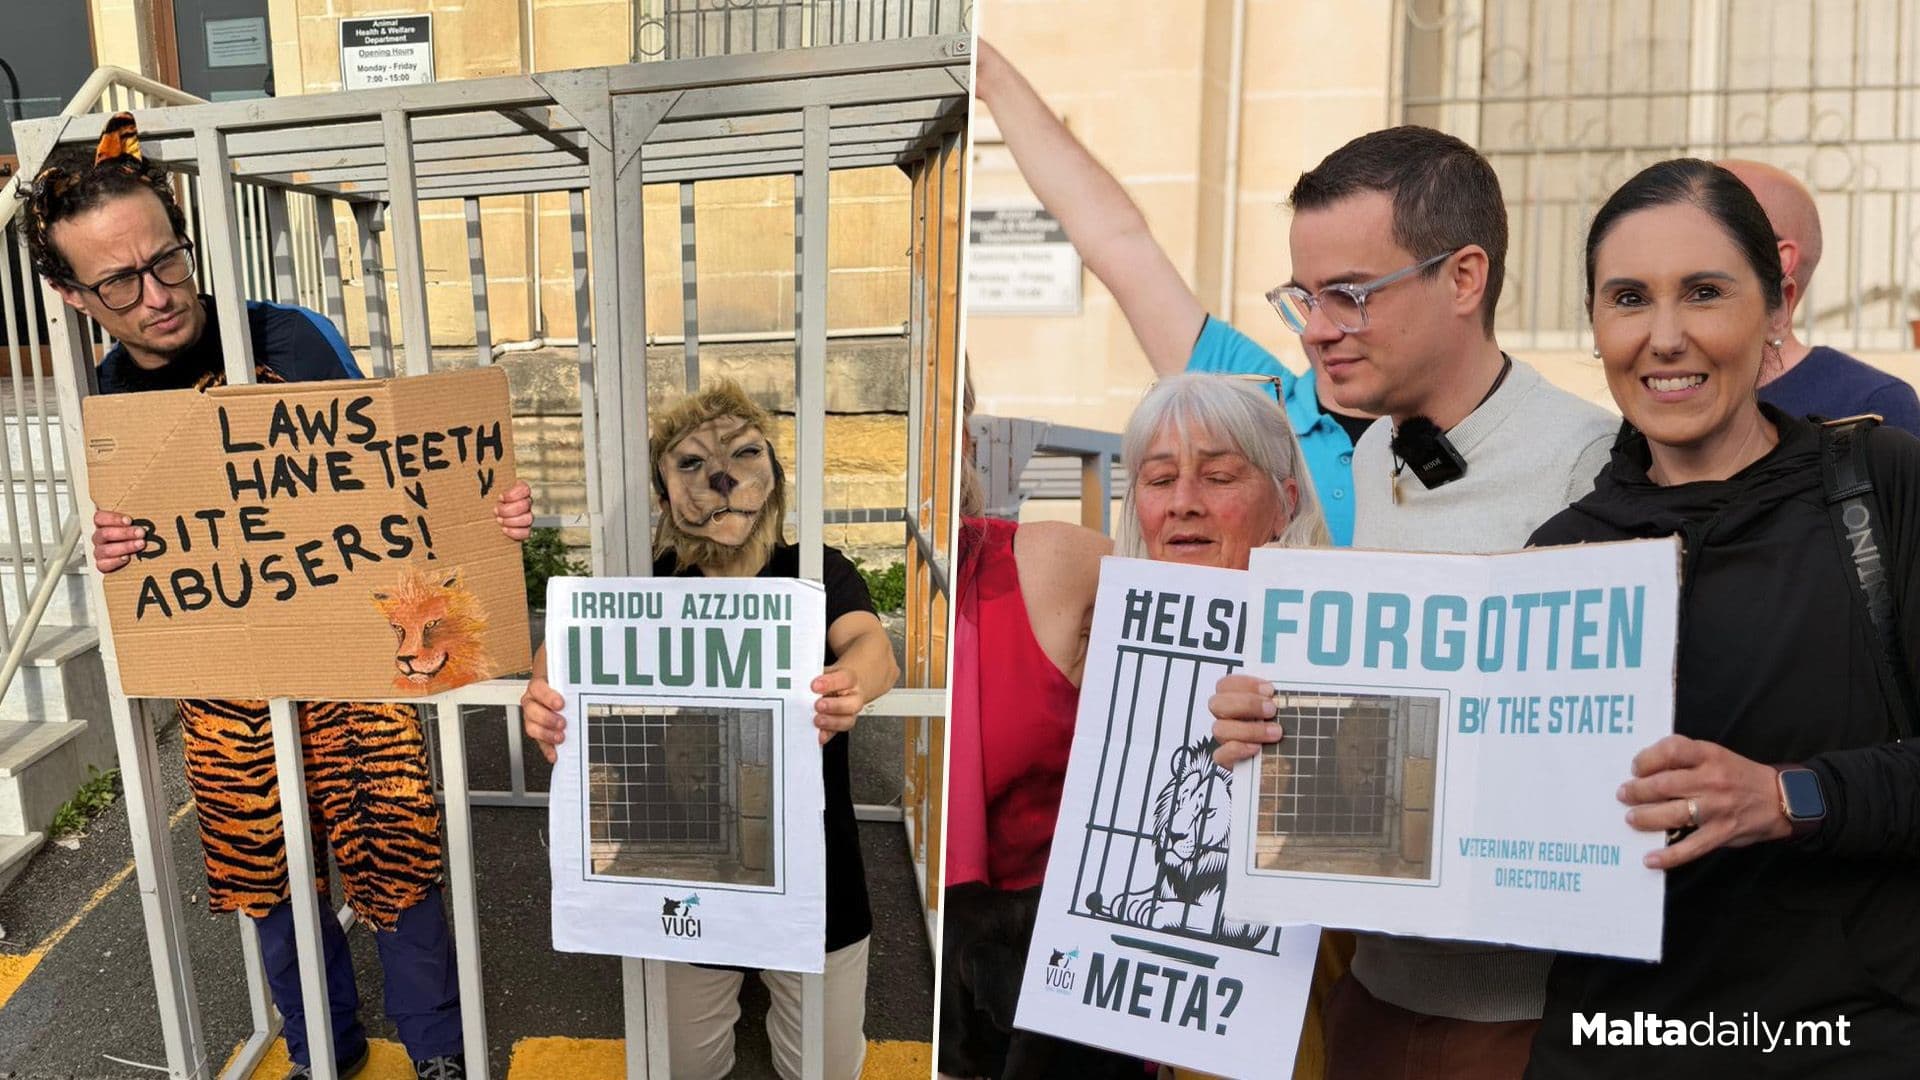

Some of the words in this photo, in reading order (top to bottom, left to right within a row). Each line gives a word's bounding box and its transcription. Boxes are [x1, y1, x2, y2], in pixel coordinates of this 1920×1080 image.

[355, 28, 380, 37] Health
[380, 27, 387, 35] &
[387, 26, 416, 34] Welfare
[372, 19, 399, 27] Animal
[358, 49, 391, 58] Opening
[392, 48, 414, 57] Hours
[364, 35, 407, 45] Department
[357, 64, 387, 73] Monday
[393, 62, 418, 71] Friday
[366, 75, 383, 83] 7:00
[389, 73, 410, 82] 15:00
[218, 396, 377, 453] LAWS
[226, 450, 365, 500] HAVE
[364, 420, 504, 489] TEETH
[131, 506, 286, 562] BITE
[136, 514, 437, 621] ABUSERS!
[572, 591, 663, 620] IRRIDU
[680, 593, 792, 621] AZZJONI
[1260, 585, 1646, 673] FORGOTTEN
[567, 625, 792, 690] ILLUM!
[1458, 696, 1490, 734] BY
[1497, 696, 1541, 734] THE
[1548, 694, 1635, 734] STATE!
[1538, 842, 1620, 866] REGULATION
[1495, 867, 1582, 893] DIRECTORATE
[1082, 952, 1245, 1036] META?
